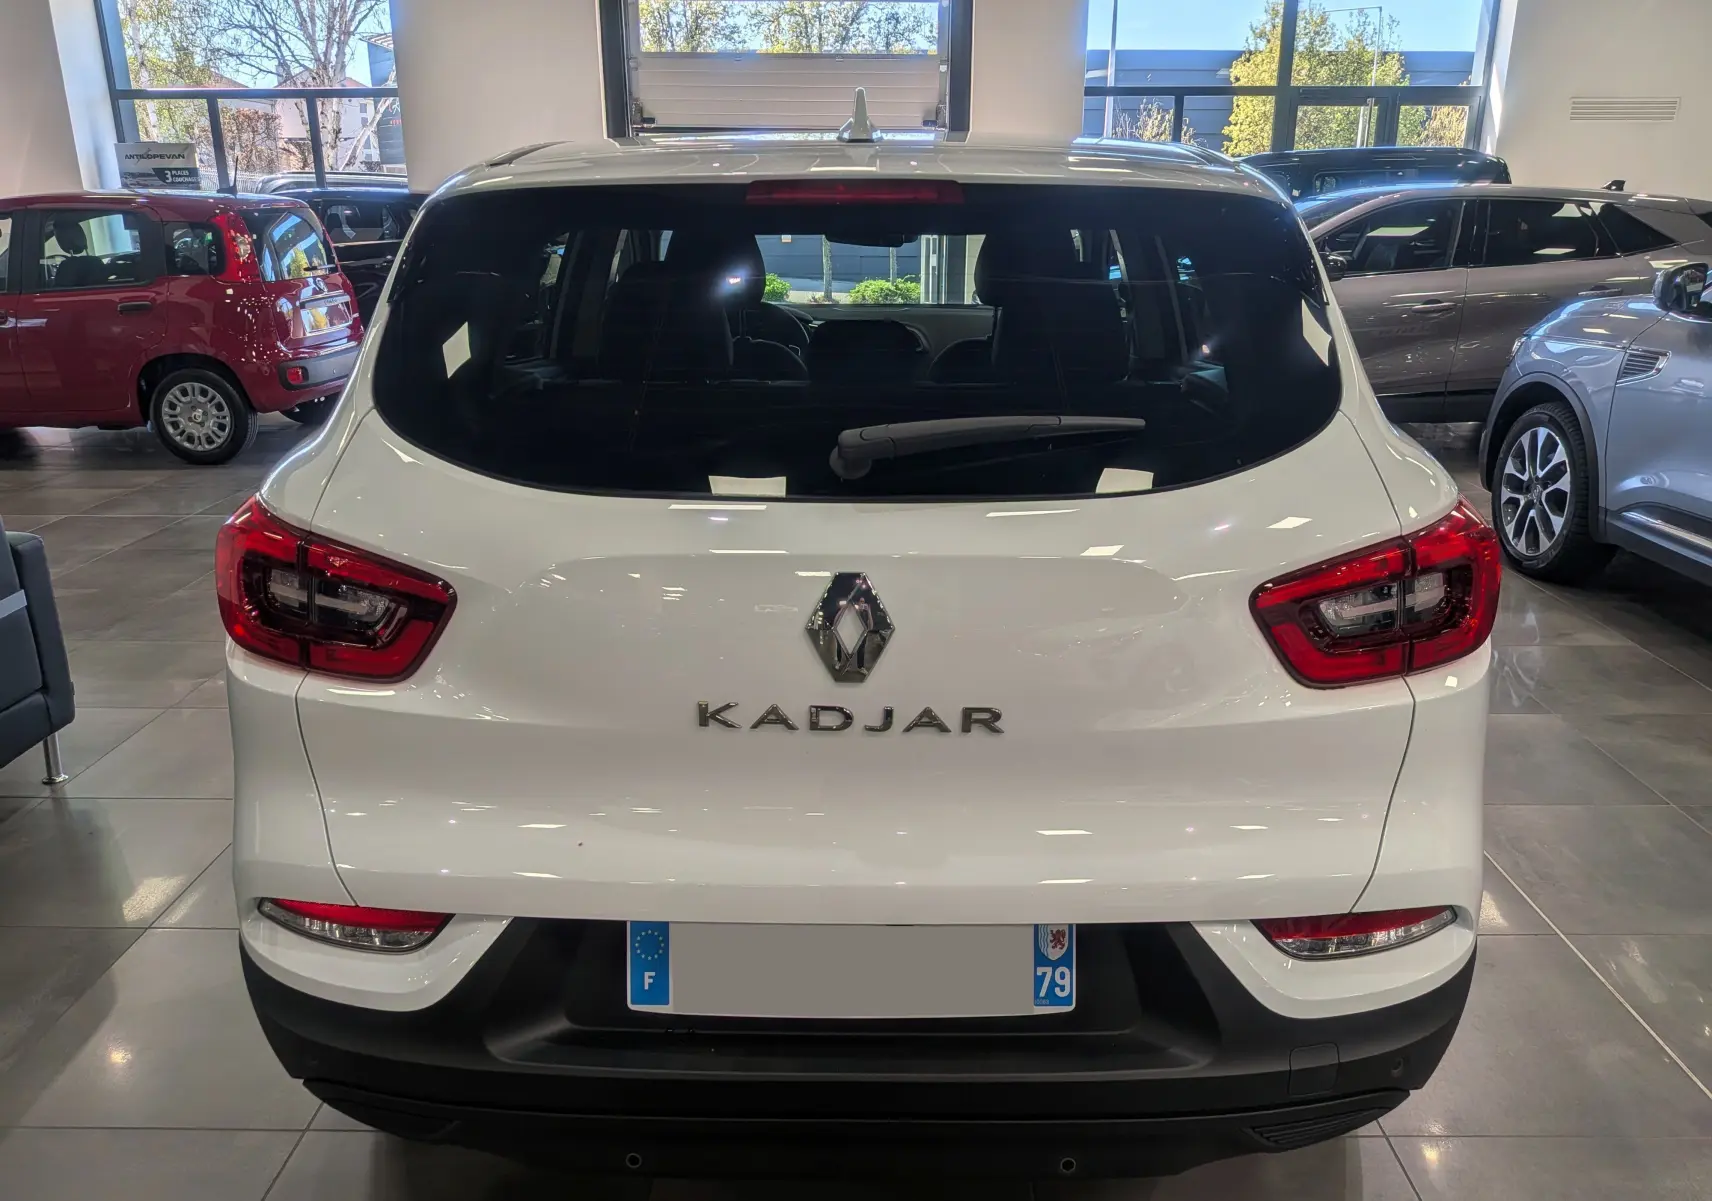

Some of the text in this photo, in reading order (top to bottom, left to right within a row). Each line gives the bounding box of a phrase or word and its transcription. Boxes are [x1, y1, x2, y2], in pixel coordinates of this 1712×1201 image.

[164, 170, 172, 183] 3
[697, 700, 1005, 733] KADJAR
[644, 971, 656, 990] F
[1036, 966, 1071, 998] 79
